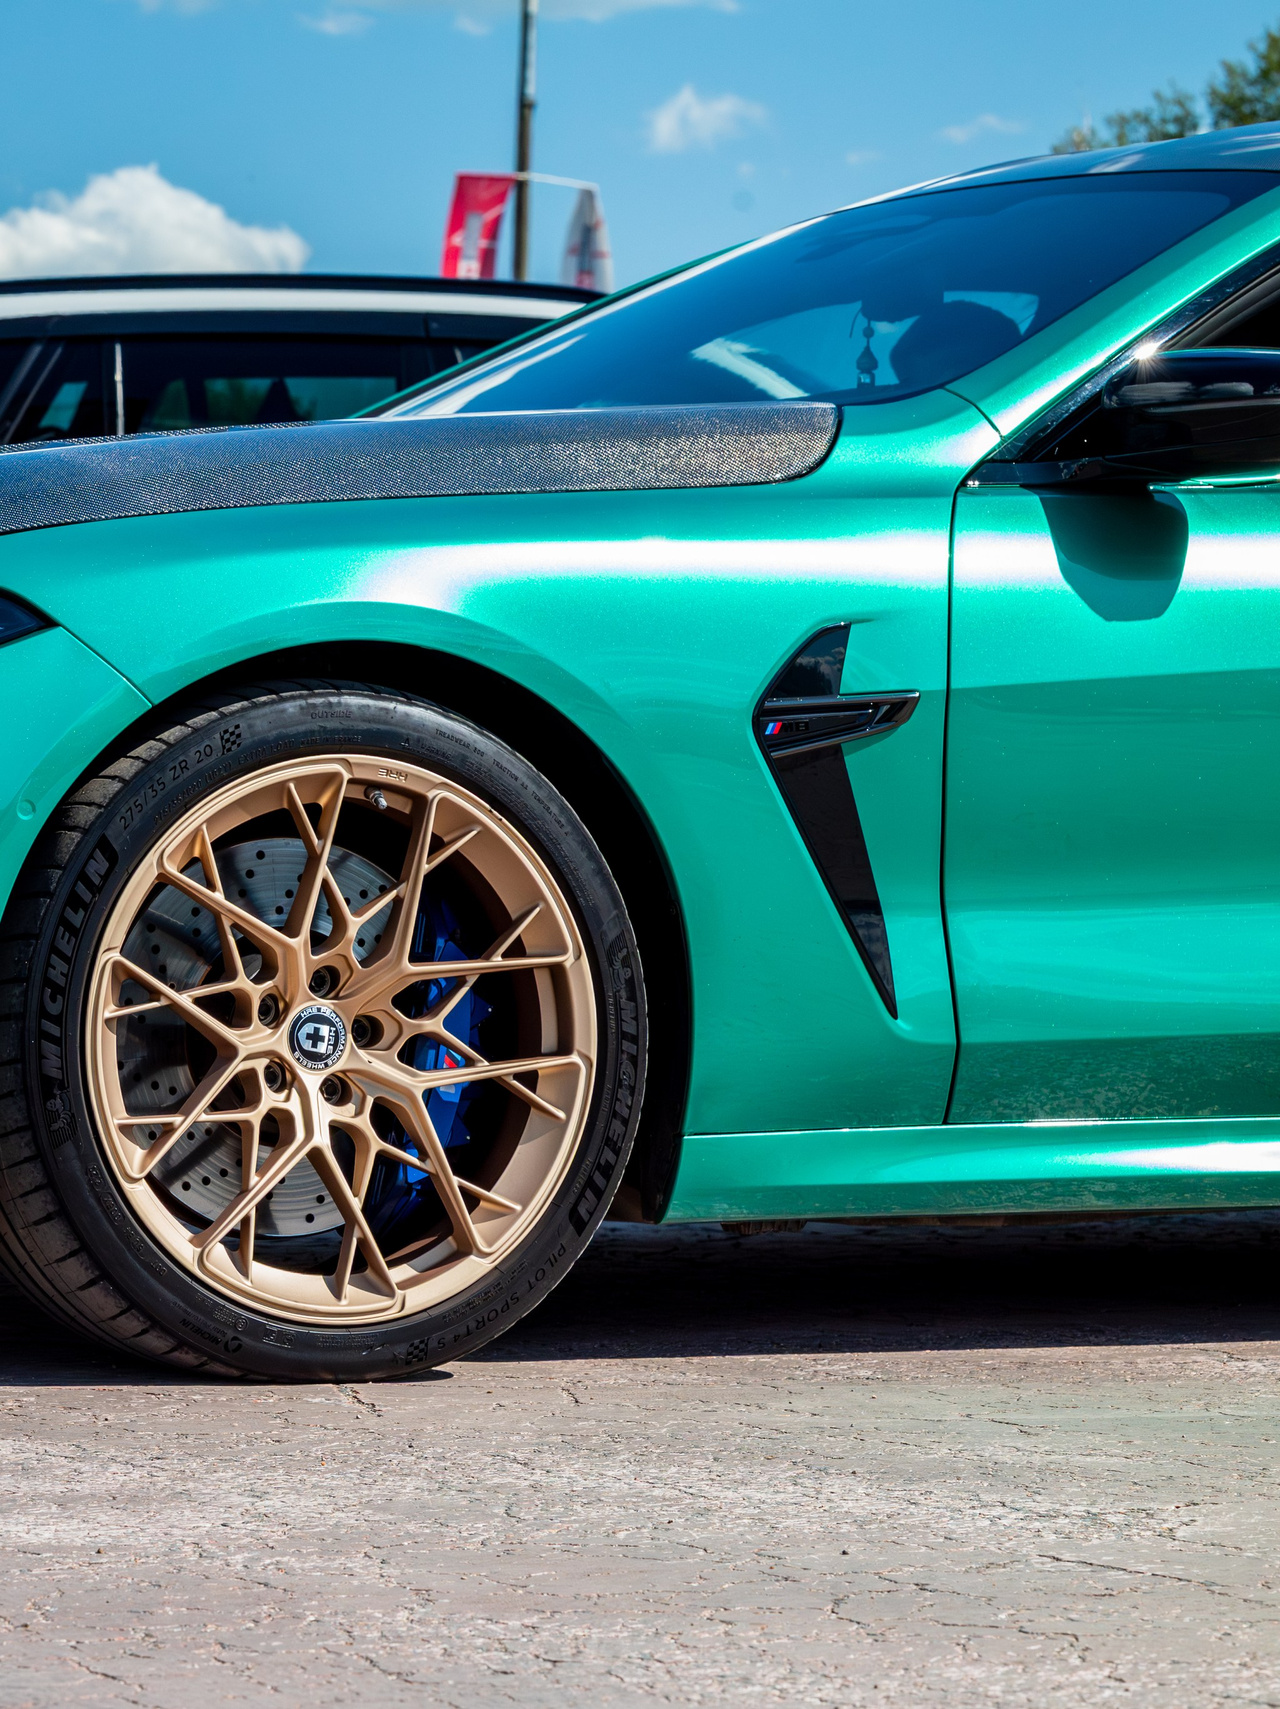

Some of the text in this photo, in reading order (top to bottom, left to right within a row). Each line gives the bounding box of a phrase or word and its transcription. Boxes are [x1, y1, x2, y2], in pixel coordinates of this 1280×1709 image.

[117, 742, 214, 831] 275/35 ZR 20
[39, 845, 111, 1079] MICHELIN
[326, 1027, 336, 1055] HRE
[574, 999, 637, 1224] MICHELIN
[523, 1241, 567, 1293] PILOT
[178, 1316, 222, 1347] MICHELIN
[435, 1336, 446, 1350] S
